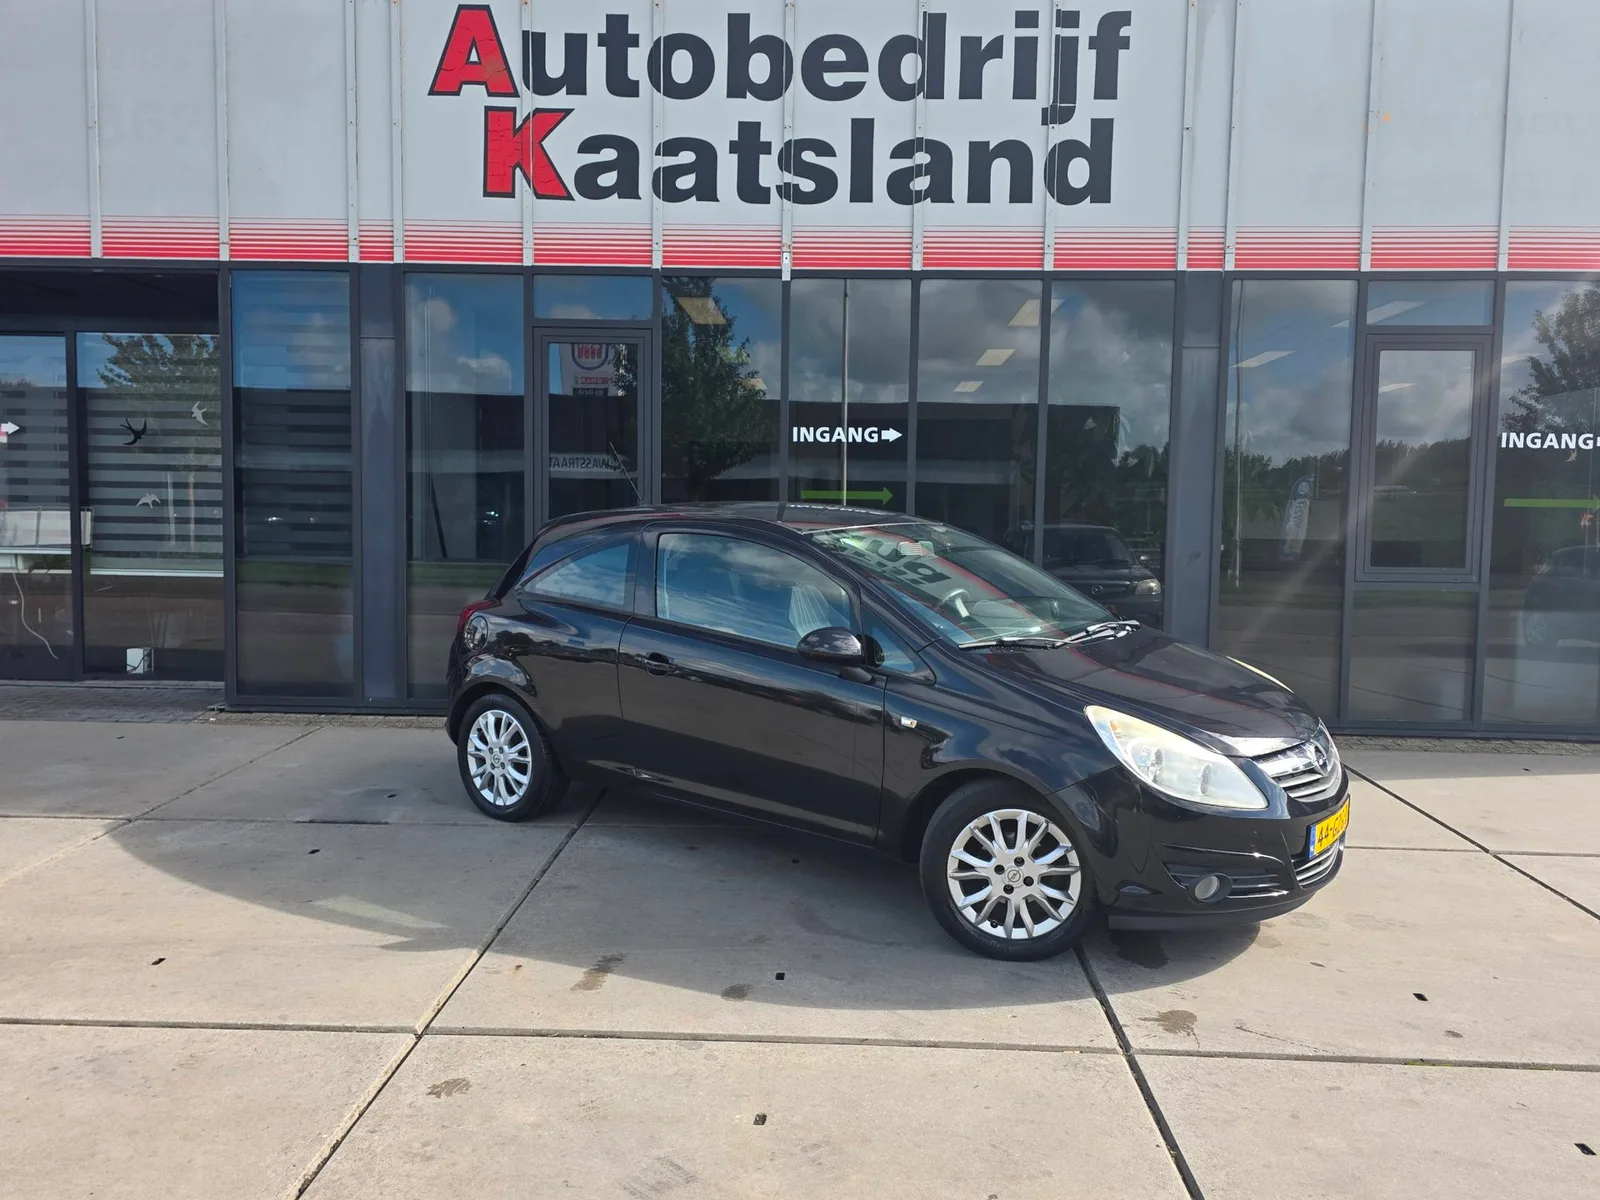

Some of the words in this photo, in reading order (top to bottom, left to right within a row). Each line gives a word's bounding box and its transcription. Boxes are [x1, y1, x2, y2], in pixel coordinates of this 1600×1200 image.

[428, 4, 1132, 126] Autobedrijf
[482, 106, 1115, 205] Kaatsland
[792, 426, 879, 443] INGANG
[1501, 432, 1594, 450] INGANG
